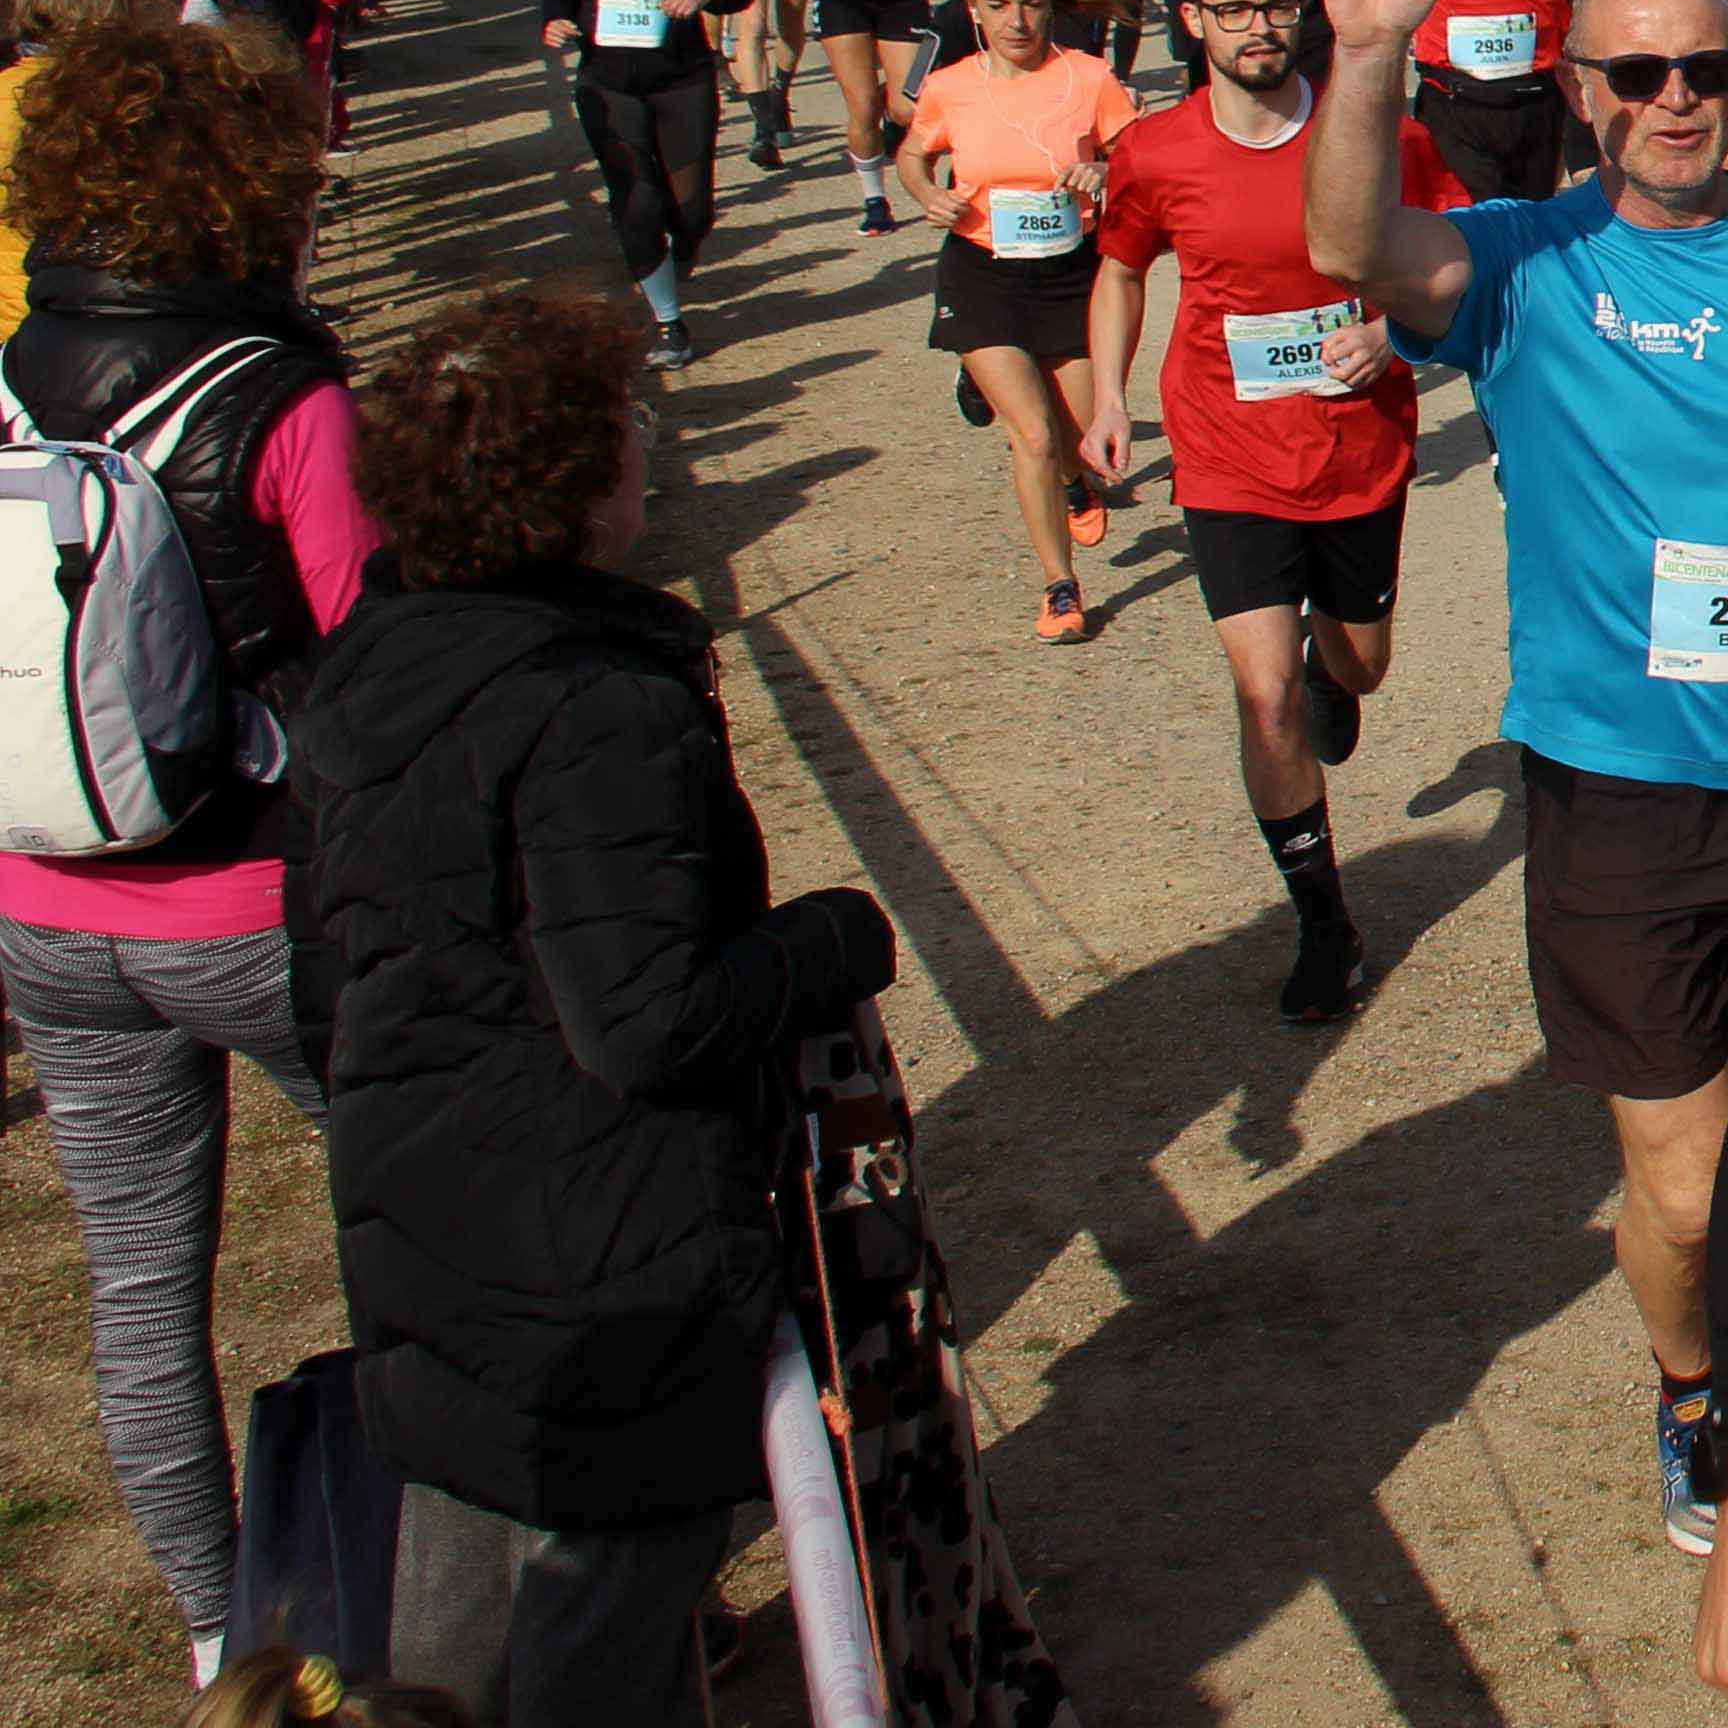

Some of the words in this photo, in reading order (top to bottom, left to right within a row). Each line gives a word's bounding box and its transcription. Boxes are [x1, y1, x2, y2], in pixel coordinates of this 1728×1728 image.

[616, 12, 650, 27] 3138
[1474, 38, 1514, 54] 2936
[1018, 214, 1062, 231] 2862
[1265, 341, 1323, 366] 2697
[1277, 364, 1323, 378] ALEXIS
